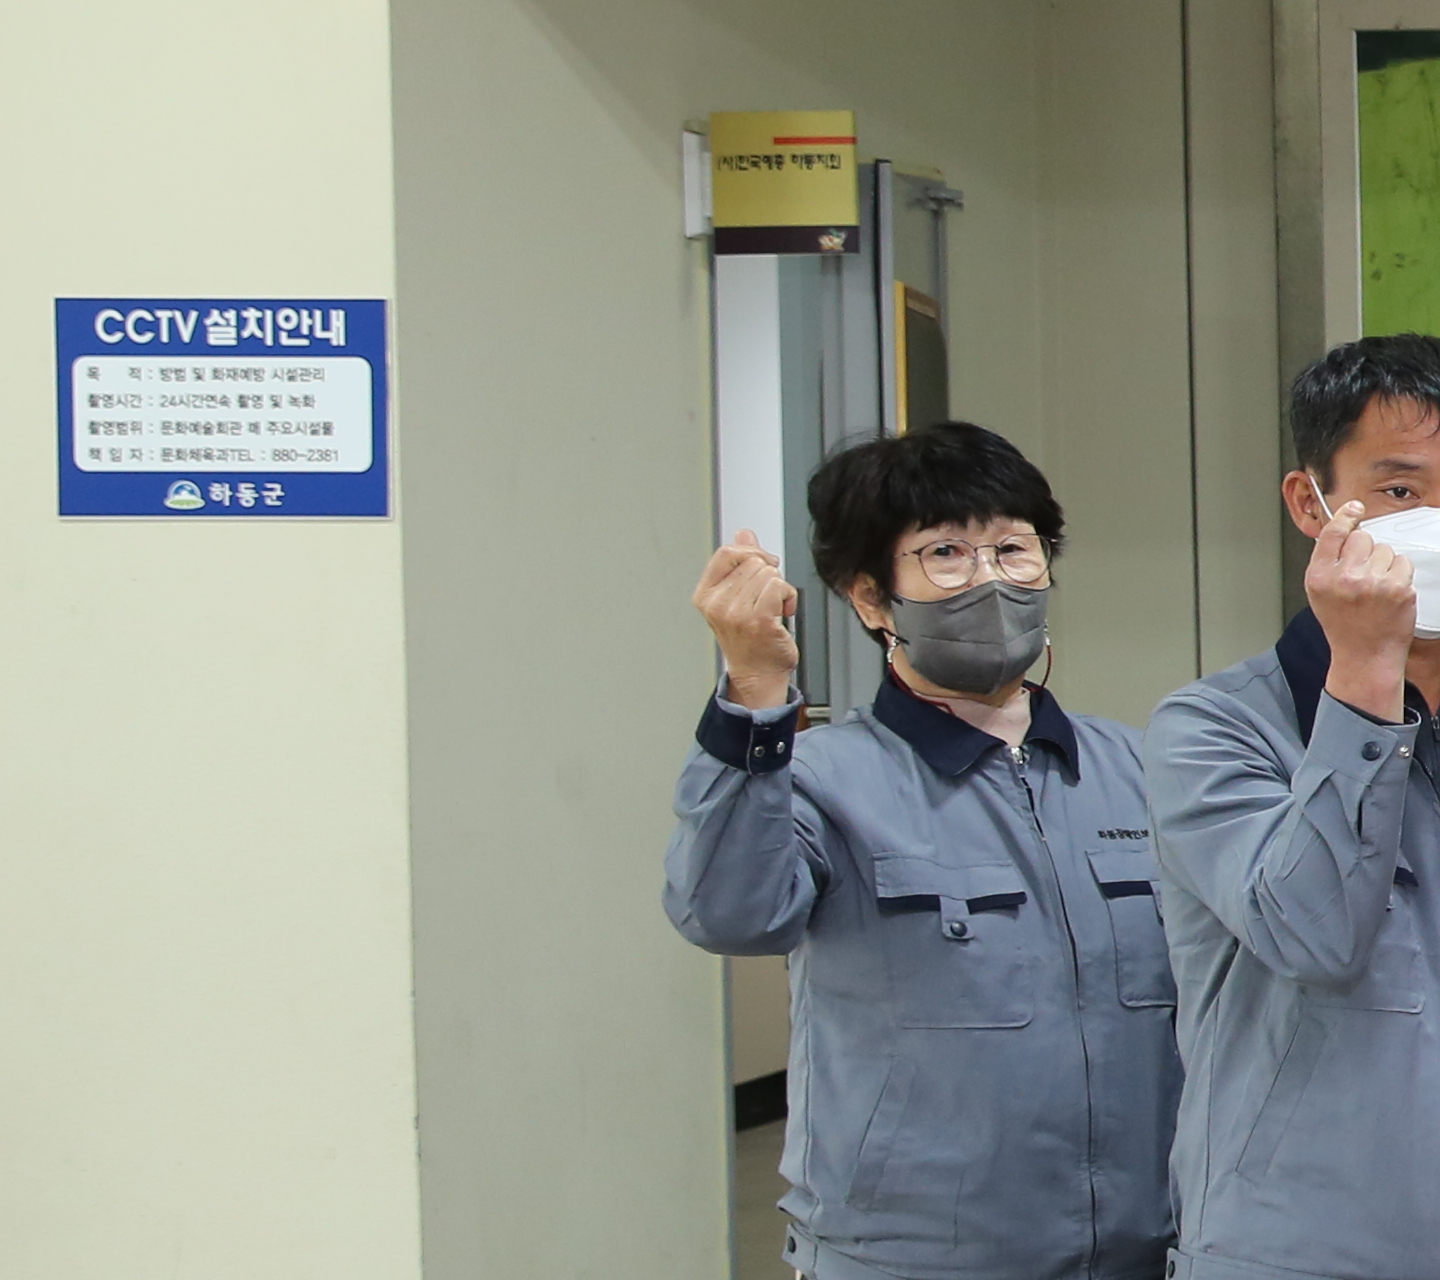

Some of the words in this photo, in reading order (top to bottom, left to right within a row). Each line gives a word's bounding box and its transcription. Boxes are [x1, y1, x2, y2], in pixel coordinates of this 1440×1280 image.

[95, 308, 199, 344] CCTV
[204, 307, 347, 347] 설치안내
[208, 483, 286, 508] 하동군
